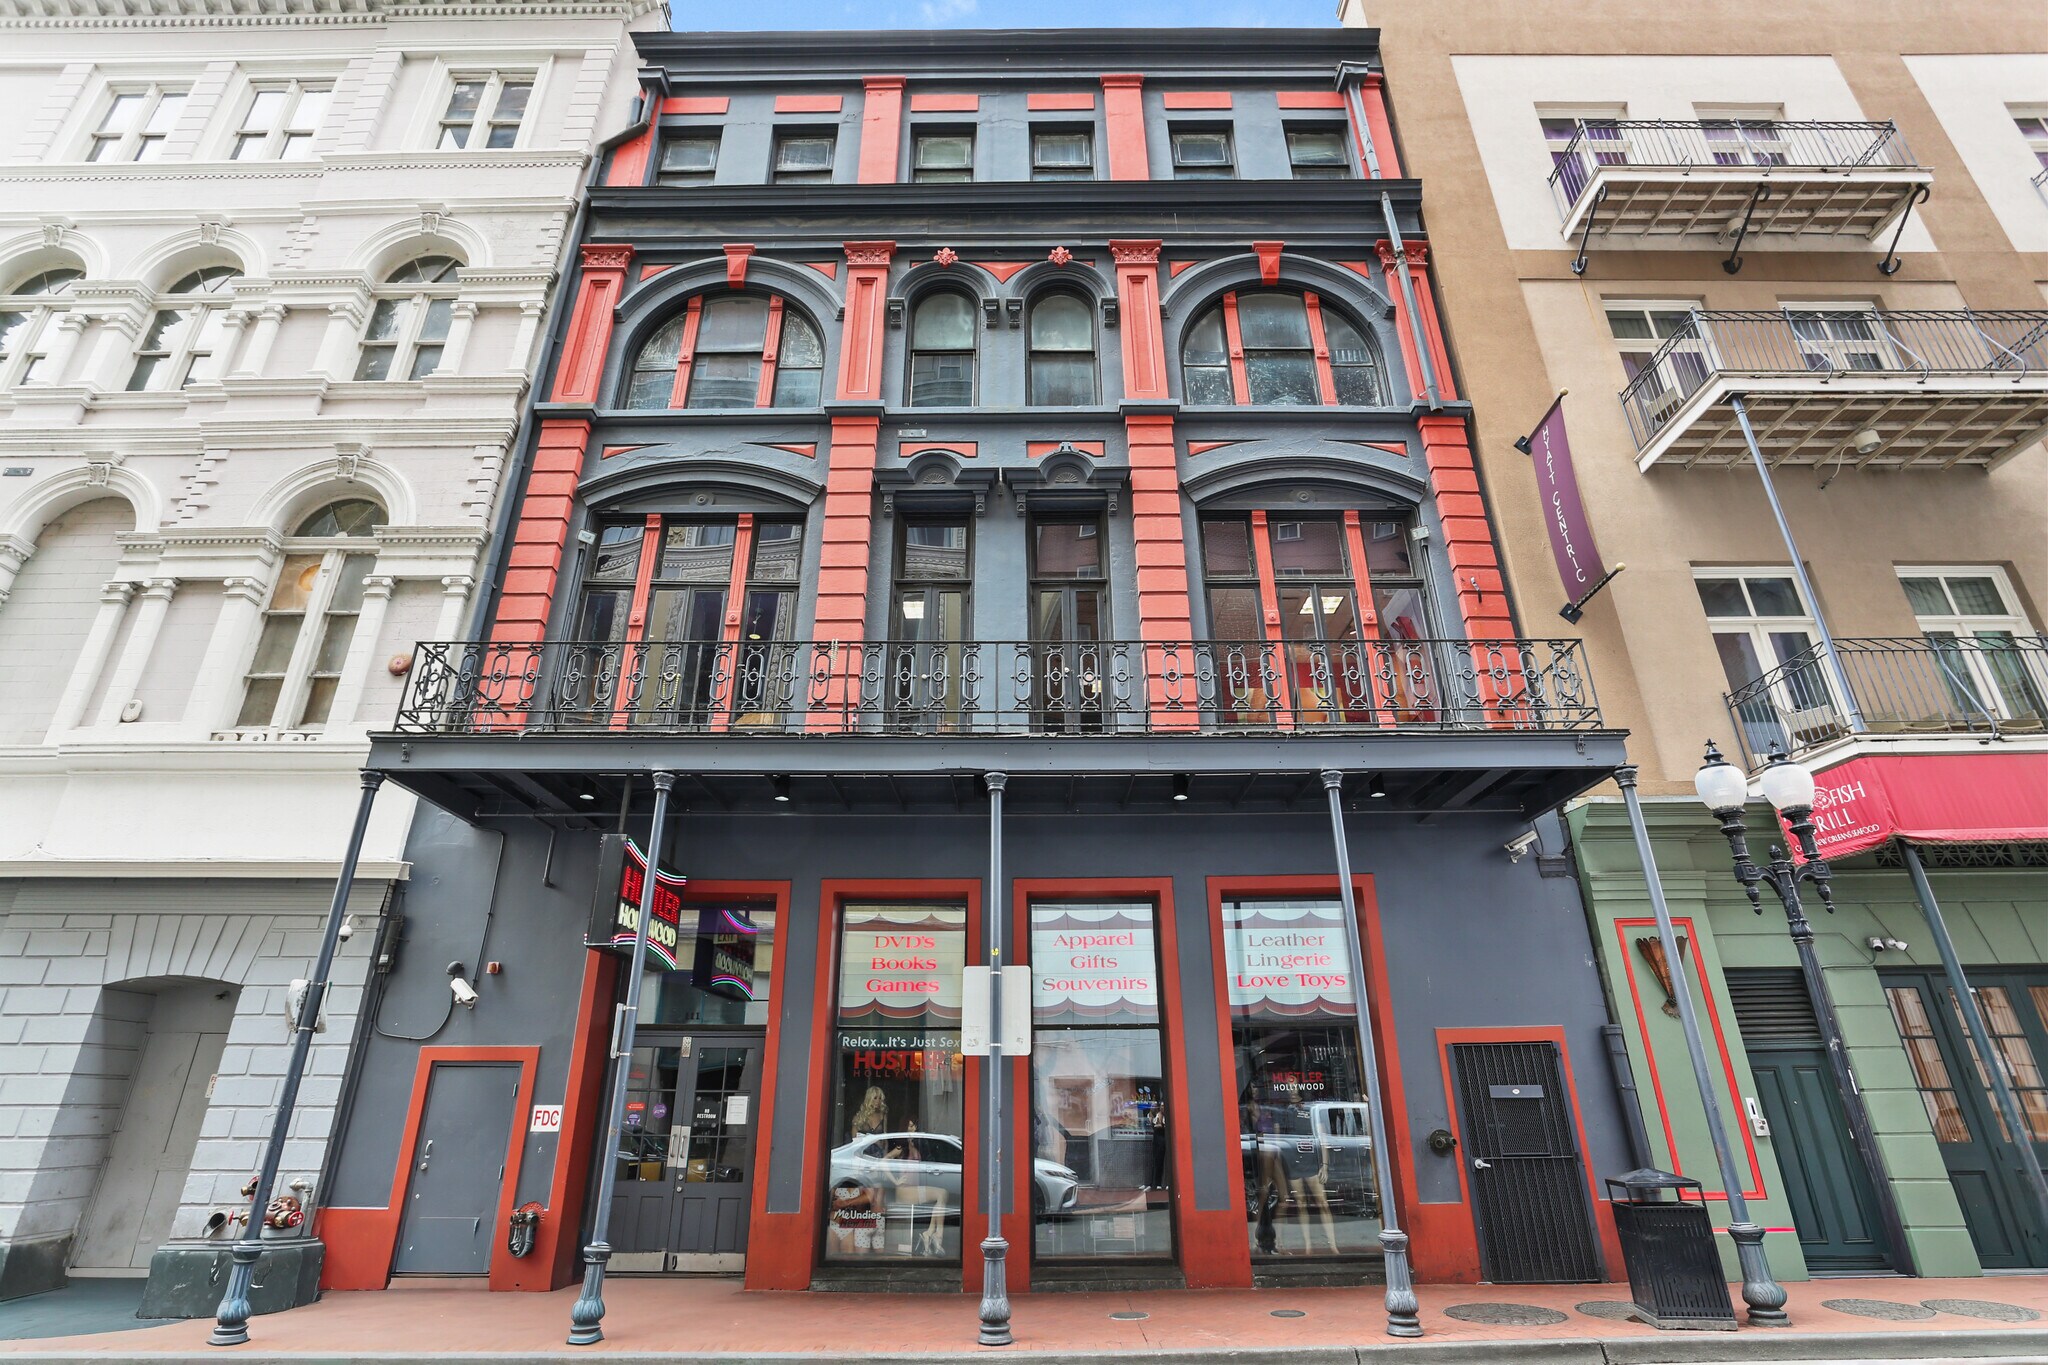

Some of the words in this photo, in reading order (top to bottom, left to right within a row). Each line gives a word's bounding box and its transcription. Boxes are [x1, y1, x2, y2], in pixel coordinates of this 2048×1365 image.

[1542, 425, 1555, 484] HYATT
[1552, 490, 1586, 583] CENTRIC
[1829, 780, 1866, 807] FISH
[621, 865, 681, 925] HUTLER
[618, 902, 677, 948] HOLWOOD
[874, 935, 936, 949] DVD's
[1053, 932, 1135, 950] Apparel
[1248, 933, 1325, 947] Leather
[871, 956, 938, 971] Books
[1070, 954, 1118, 969] Gifts
[1247, 953, 1332, 969] Lingerie
[865, 978, 940, 993] Games
[1042, 976, 1148, 992] Souvenirs
[1237, 974, 1290, 988] Love
[1294, 973, 1347, 990] Toys
[909, 1036, 936, 1048] Just
[939, 1037, 960, 1047] Sex
[853, 1050, 947, 1070] HUSTLER
[1272, 1072, 1323, 1083] HUSTLER
[1273, 1083, 1325, 1091] HOLLYWOOD
[533, 1110, 560, 1127] FDC
[833, 1209, 882, 1220] MeUndies
